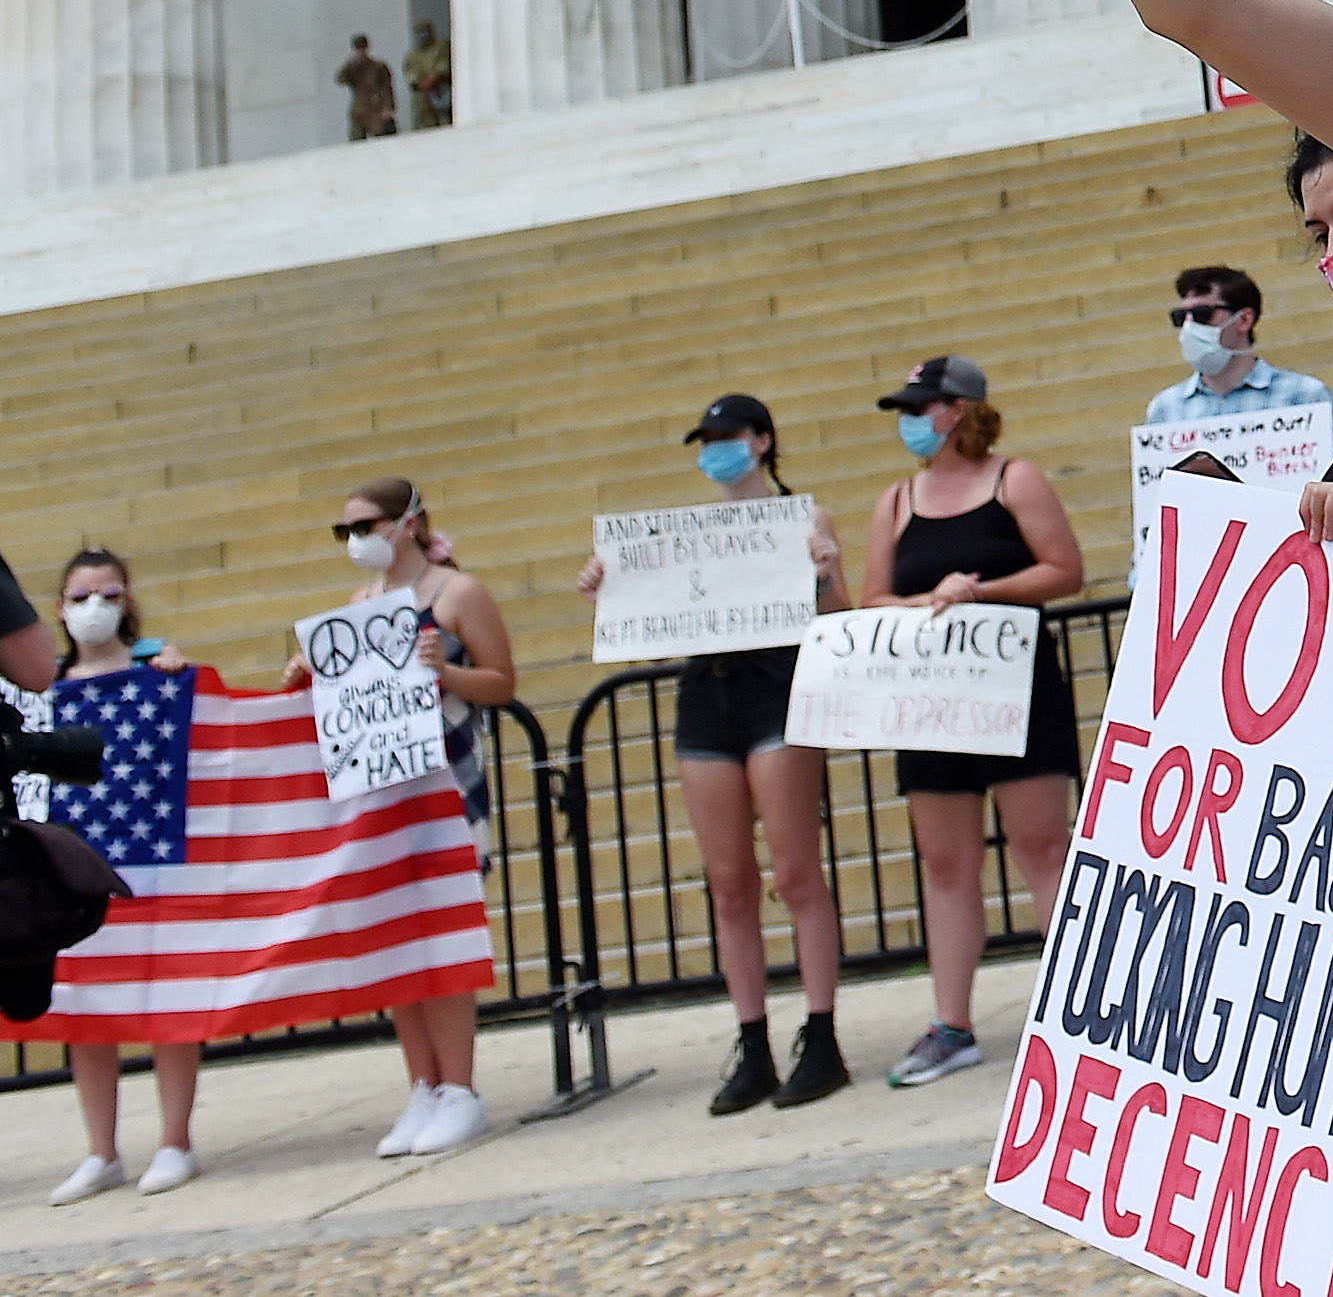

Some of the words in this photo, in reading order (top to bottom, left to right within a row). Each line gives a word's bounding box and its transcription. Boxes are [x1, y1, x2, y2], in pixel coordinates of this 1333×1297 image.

[619, 540, 665, 572] BUILT
[673, 536, 697, 564] BY
[702, 531, 777, 559] SLAVES
[801, 691, 861, 738] THE
[879, 693, 1023, 739] OPPRESSOR
[366, 736, 442, 786] HATE
[1081, 720, 1244, 884] FOR
[1033, 851, 1250, 1084] FUCKING
